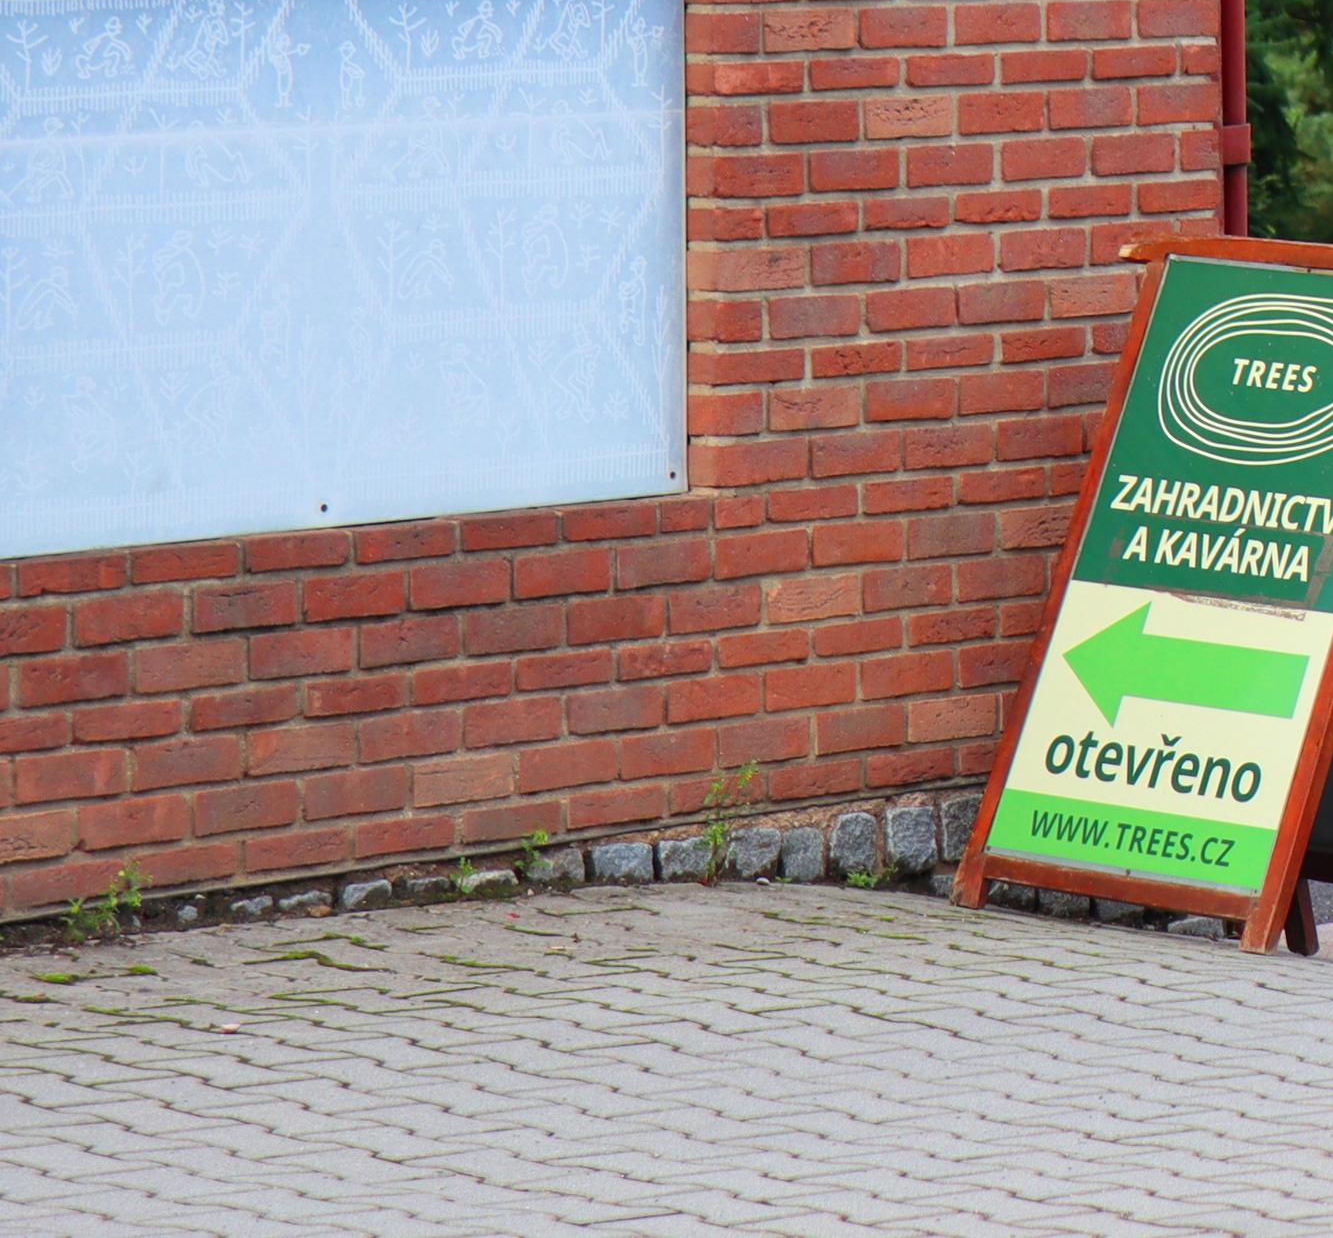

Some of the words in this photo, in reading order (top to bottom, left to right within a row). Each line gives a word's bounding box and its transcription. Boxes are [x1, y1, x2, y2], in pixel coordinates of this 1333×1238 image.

[1232, 358, 1317, 393] TREES
[1122, 526, 1148, 562] A
[1154, 528, 1310, 582] KAVÁRNA
[1045, 731, 1261, 803] otevřeno
[1031, 810, 1235, 867] WWW.TREES.CZ
